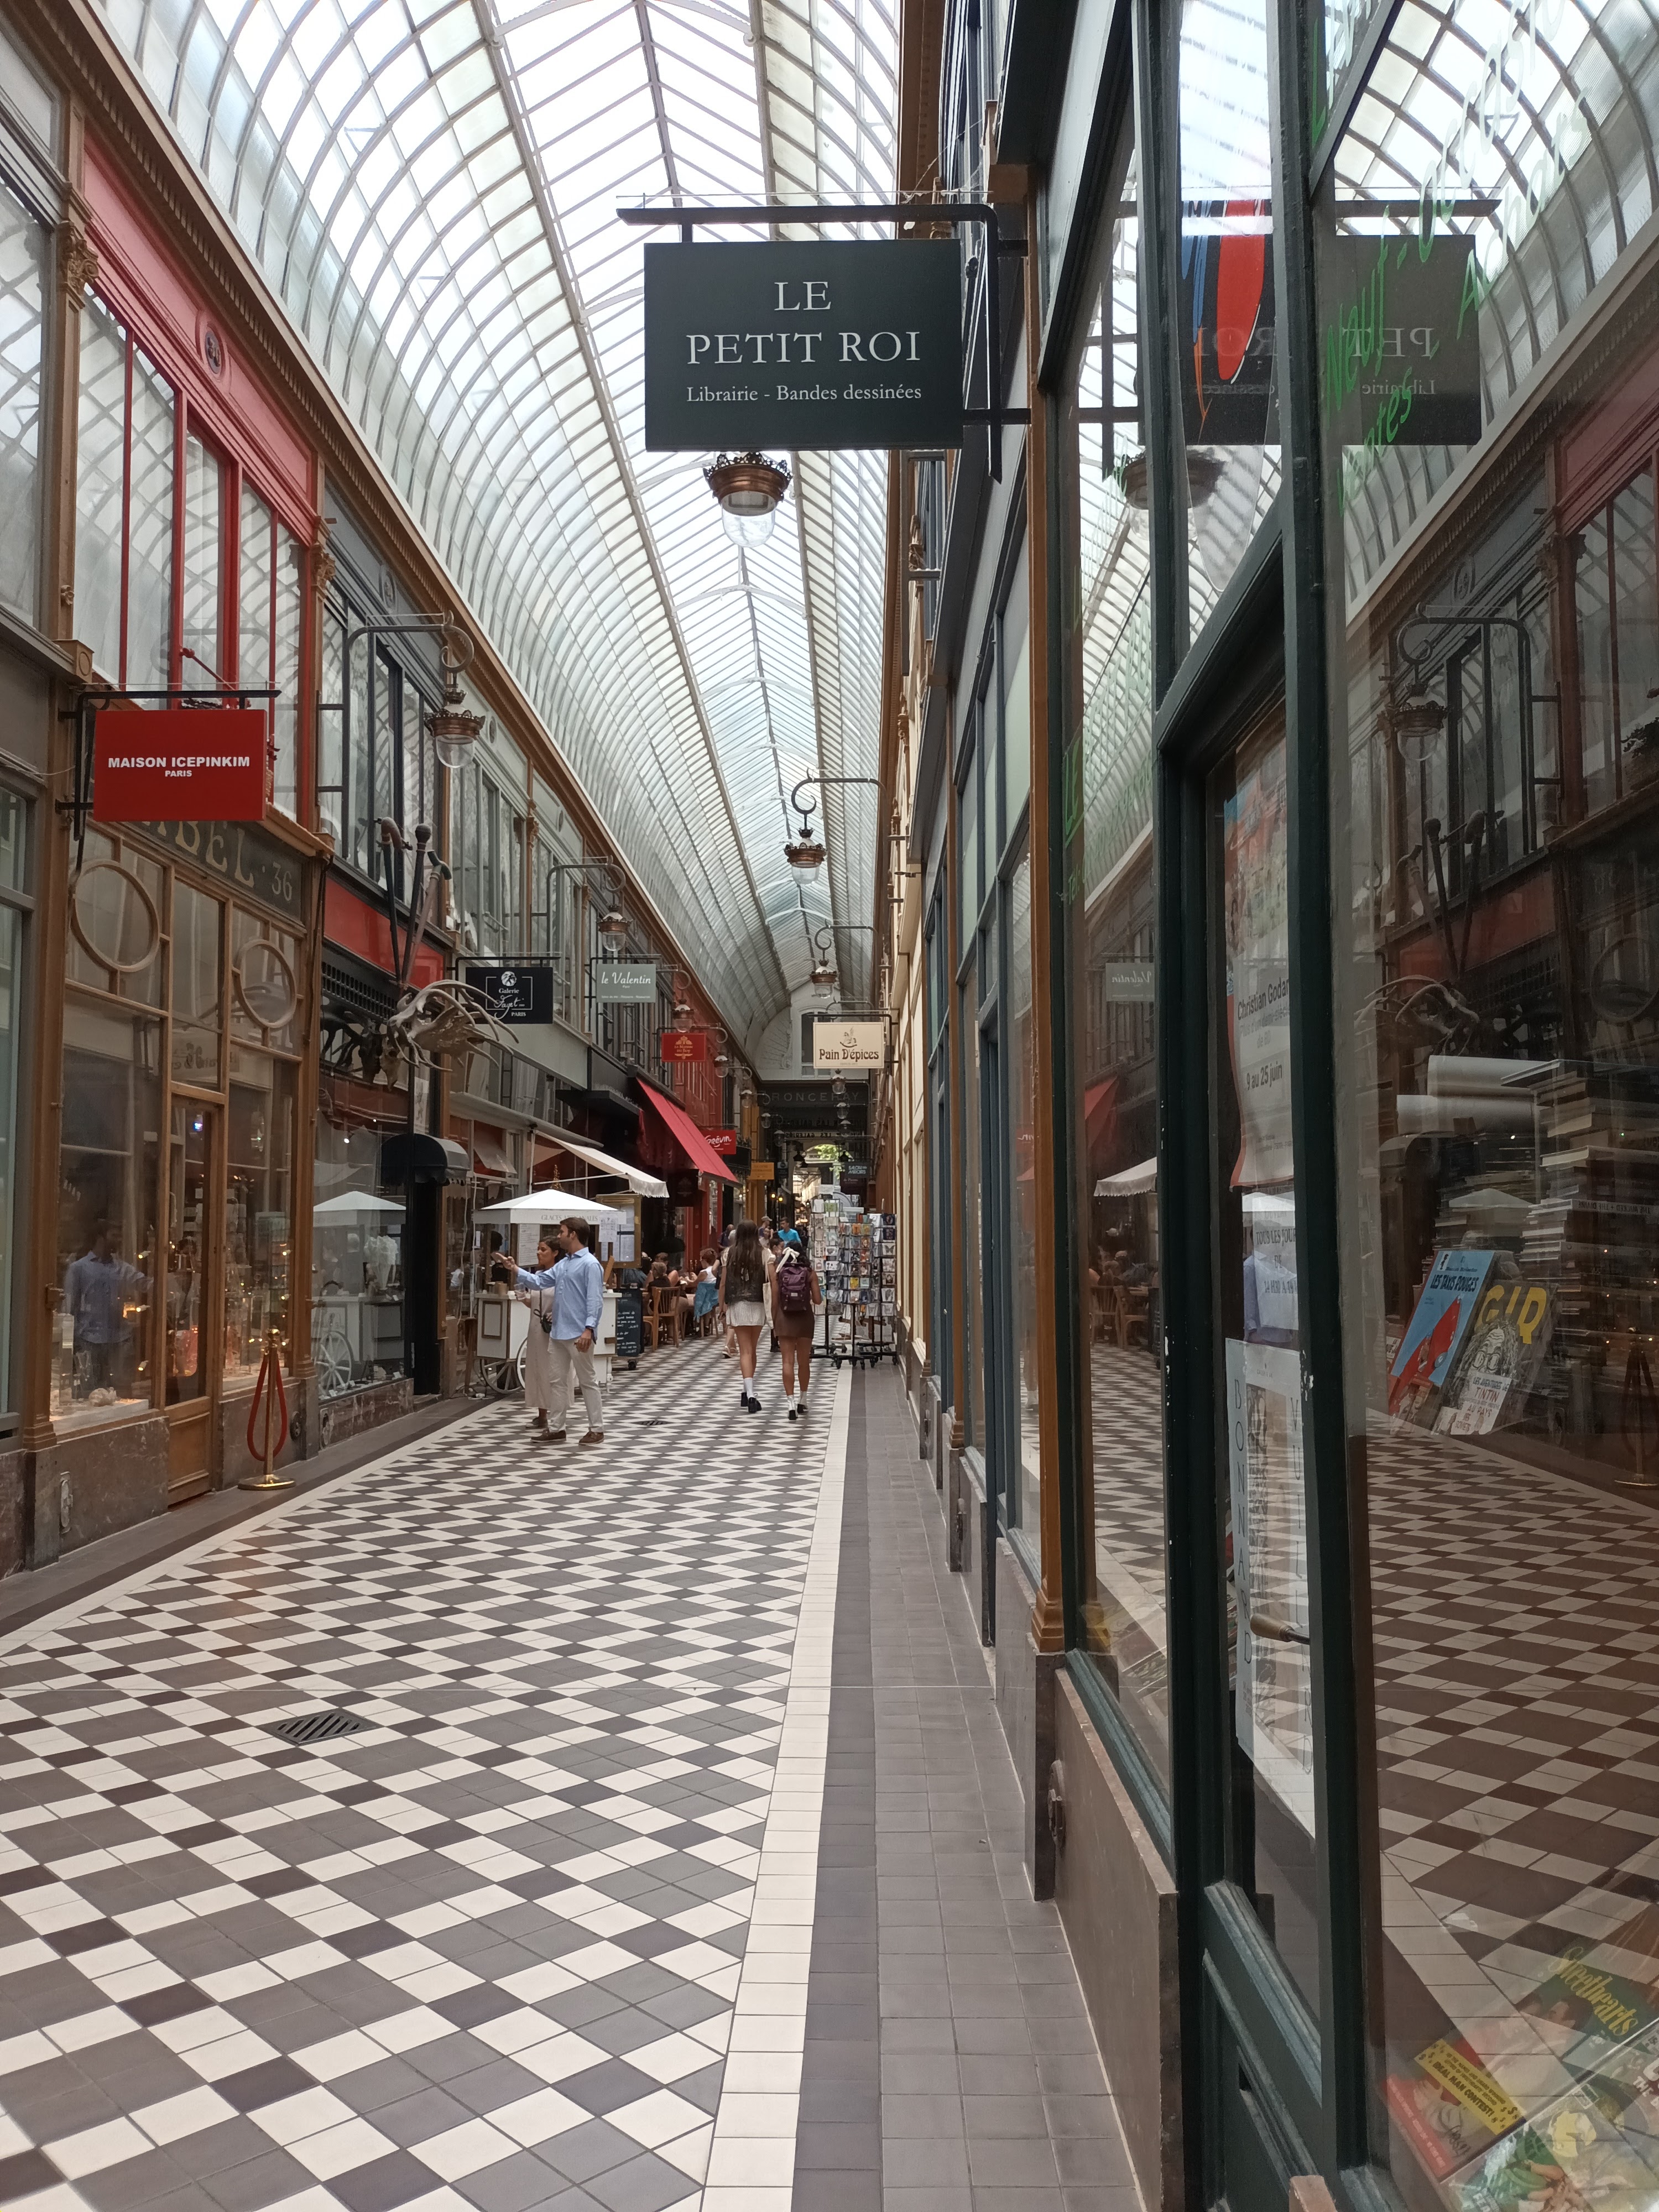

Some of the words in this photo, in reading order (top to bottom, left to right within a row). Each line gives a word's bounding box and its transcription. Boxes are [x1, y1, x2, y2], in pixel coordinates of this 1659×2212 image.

[1457, 87, 1589, 340] Achats
[775, 281, 831, 311] LE
[686, 333, 822, 364] PETIT
[839, 332, 920, 362] ROI
[686, 387, 758, 402] Librairie
[777, 385, 837, 401] Bandes
[843, 384, 921, 400] dessinées
[108, 758, 166, 768] MAISON
[171, 757, 249, 767] ICEPINKIM
[272, 862, 292, 901] 36
[601, 972, 609, 984] le
[612, 972, 651, 984] Valentin
[494, 995, 521, 1020] Fayet
[1238, 992, 1266, 1020] Christian
[1268, 977, 1289, 1004] Godar
[1257, 1033, 1263, 1048] de
[819, 1049, 839, 1060] Pain
[842, 1048, 879, 1062] D'épices
[1246, 1072, 1250, 1091] 9
[1251, 1073, 1259, 1089] au
[1260, 1065, 1269, 1086] 25
[1269, 1061, 1282, 1088] juin
[705, 1135, 732, 1147] Grévin
[1256, 1230, 1270, 1244] TOUS
[1271, 1229, 1280, 1243] LES
[1281, 1228, 1296, 1246] JOUR
[1274, 1255, 1282, 1268] DE
[1431, 1275, 1443, 1288] LES
[1439, 1275, 1457, 1290] TAXIS
[1454, 1276, 1479, 1292] ROUGES
[1474, 1387, 1500, 1402] TINTIN
[1467, 1404, 1477, 1412] AU
[1477, 1406, 1492, 1417] PAYS
[1234, 1379, 1253, 1665] BONNARD
[1556, 1946, 1639, 2036] Sweethearts
[1433, 2062, 1450, 2078] IDEAL
[1448, 2076, 1467, 2091] MAN
[1464, 2089, 1495, 2117] CONTEST!
[1633, 2076, 1654, 2097] THE
